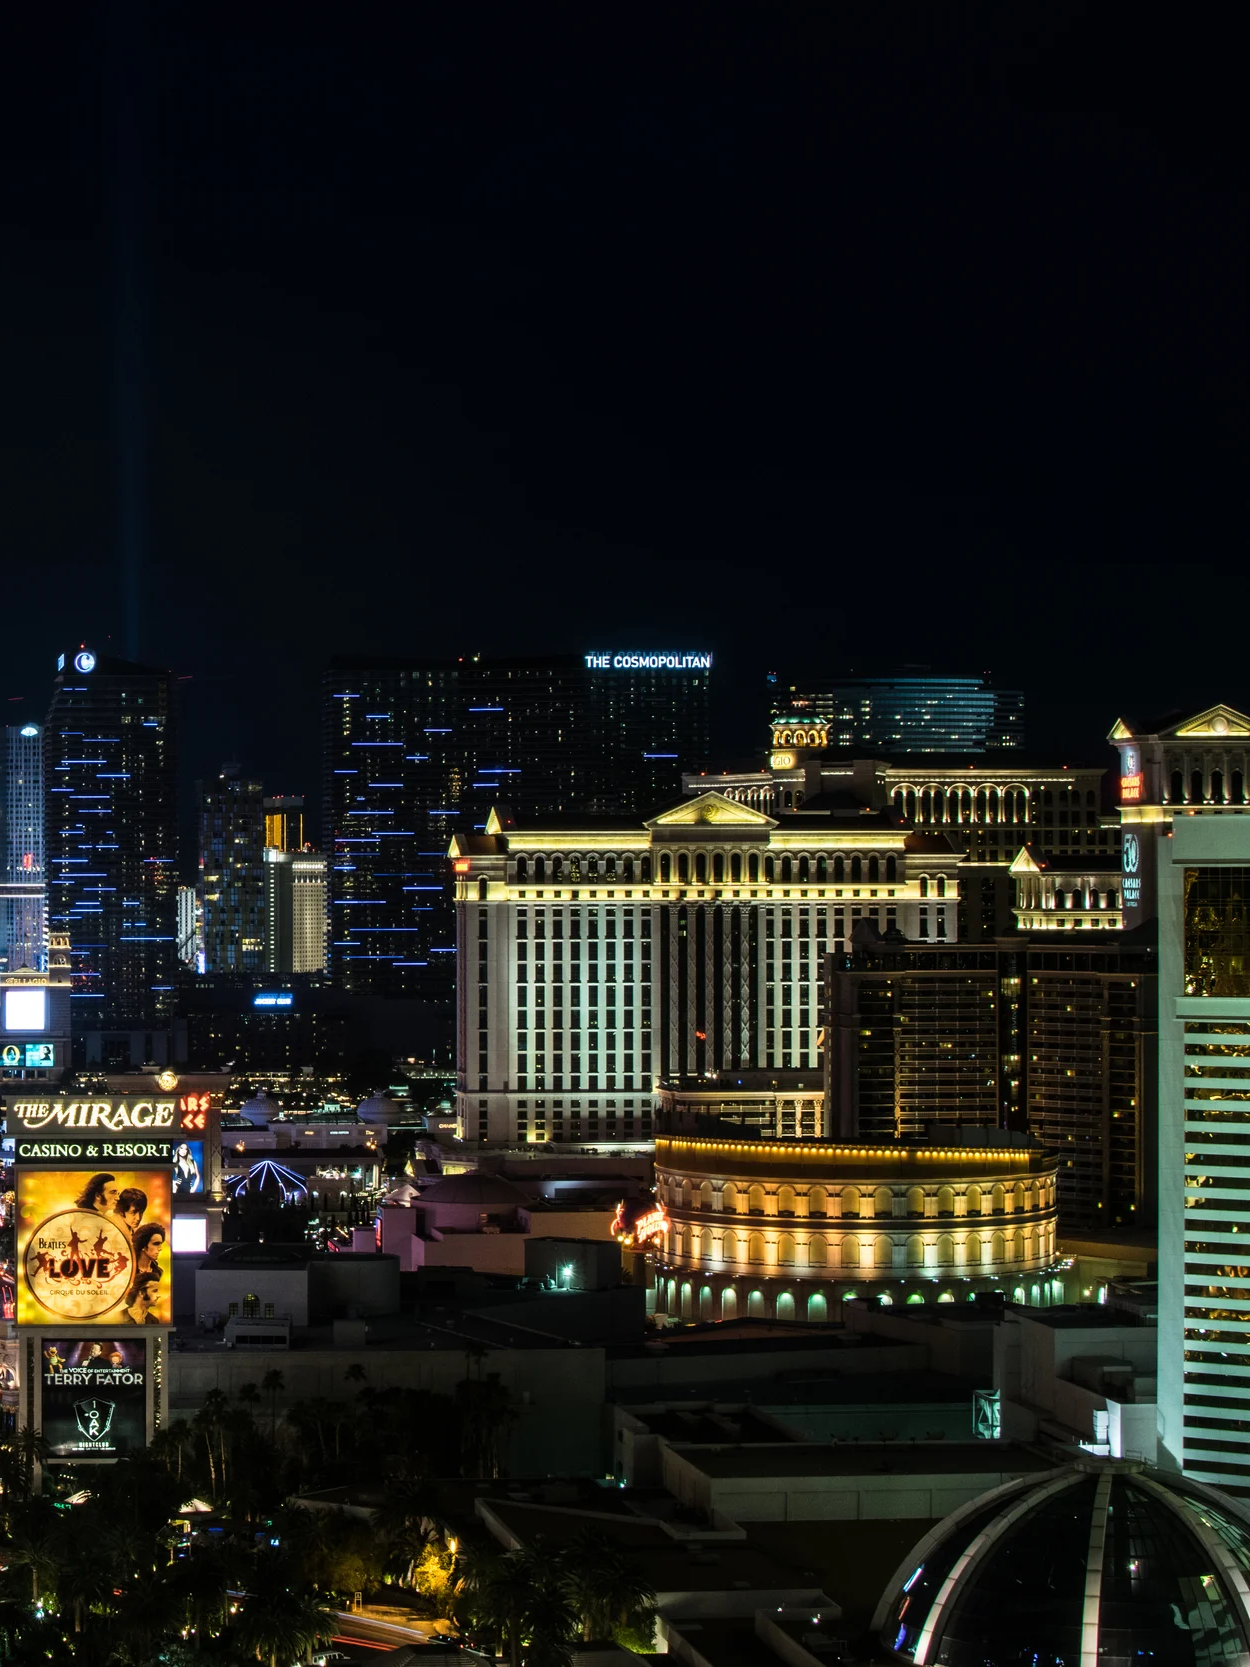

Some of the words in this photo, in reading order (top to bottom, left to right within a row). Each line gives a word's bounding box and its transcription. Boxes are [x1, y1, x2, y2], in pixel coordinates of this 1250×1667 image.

[585, 656, 611, 668] THE
[614, 656, 710, 668] COSMOPOLITAN
[1122, 878, 1141, 889] CAESARS
[1123, 889, 1140, 900] PALACE
[14, 1103, 49, 1118] THE
[23, 1102, 175, 1131] MIRAGE
[19, 1144, 82, 1158] CASINO
[85, 1144, 99, 1157] &
[103, 1144, 170, 1158] RESORT
[49, 1258, 111, 1279] LOVE
[44, 1373, 93, 1386] TERRY
[96, 1373, 144, 1386] FATOR
